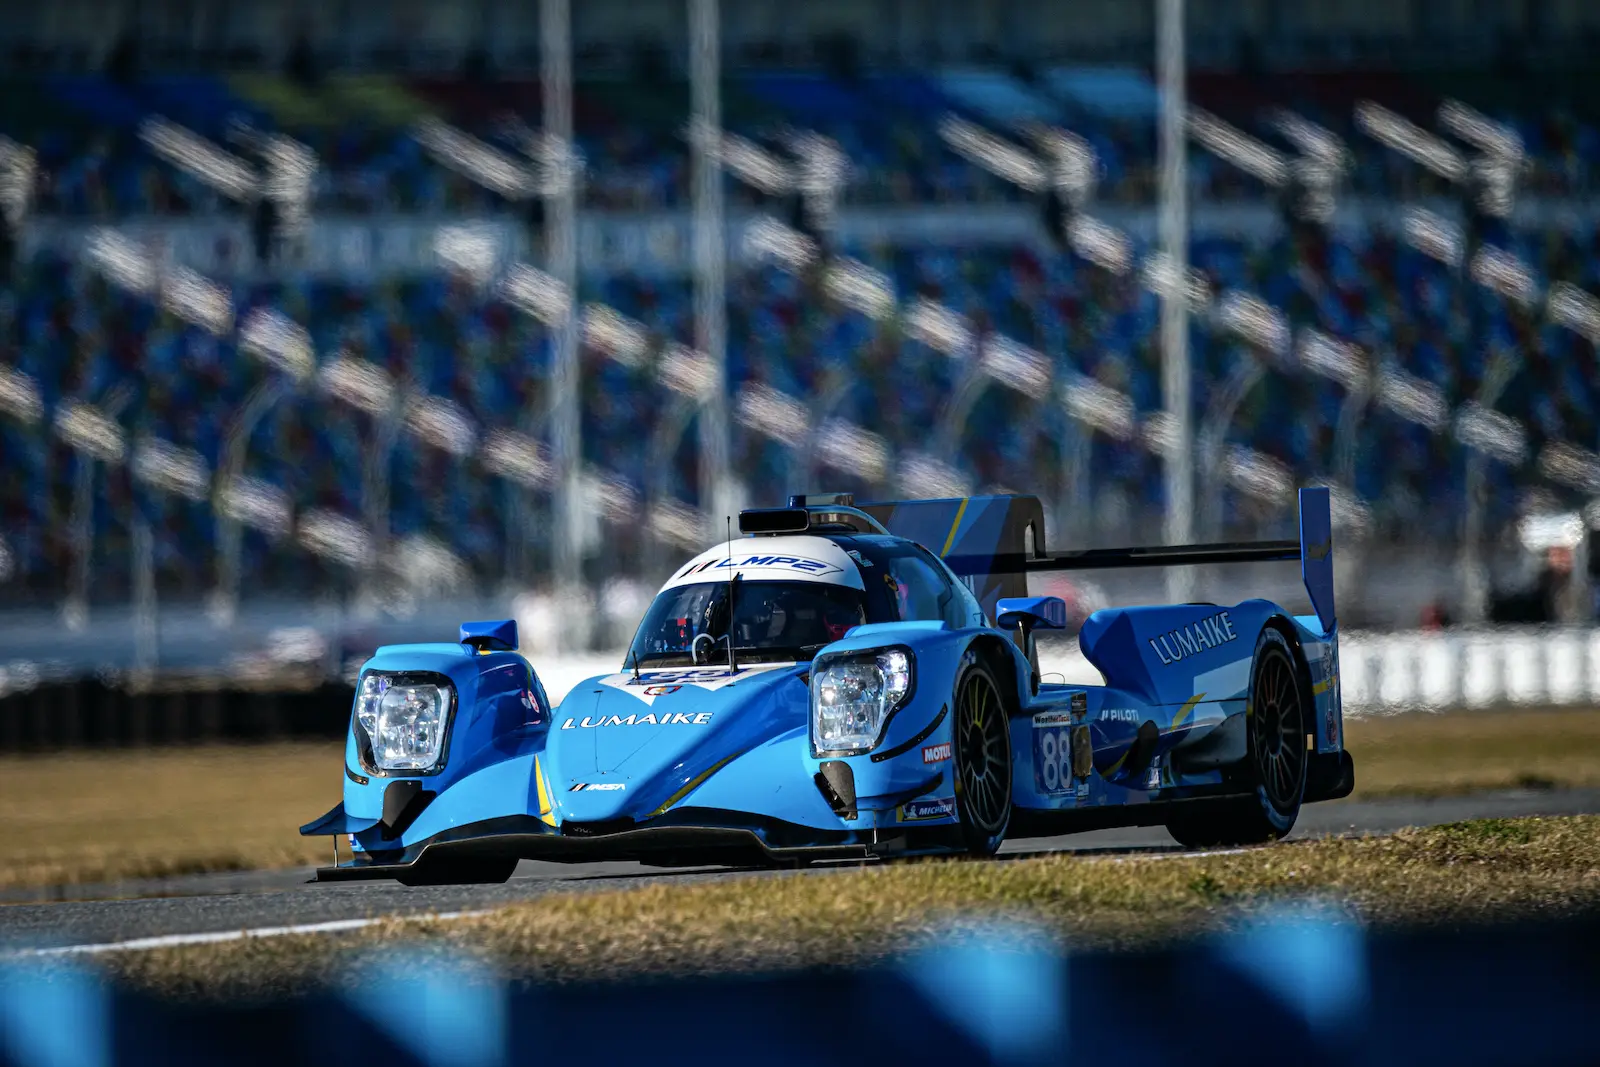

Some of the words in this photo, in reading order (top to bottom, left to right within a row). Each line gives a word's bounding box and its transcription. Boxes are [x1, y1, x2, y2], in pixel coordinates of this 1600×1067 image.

[714, 556, 827, 572] LMP2
[1149, 611, 1237, 666] LUMAIKE
[561, 712, 715, 730] LUMAIKE
[924, 744, 951, 762] MOTUL
[1042, 730, 1073, 790] 88
